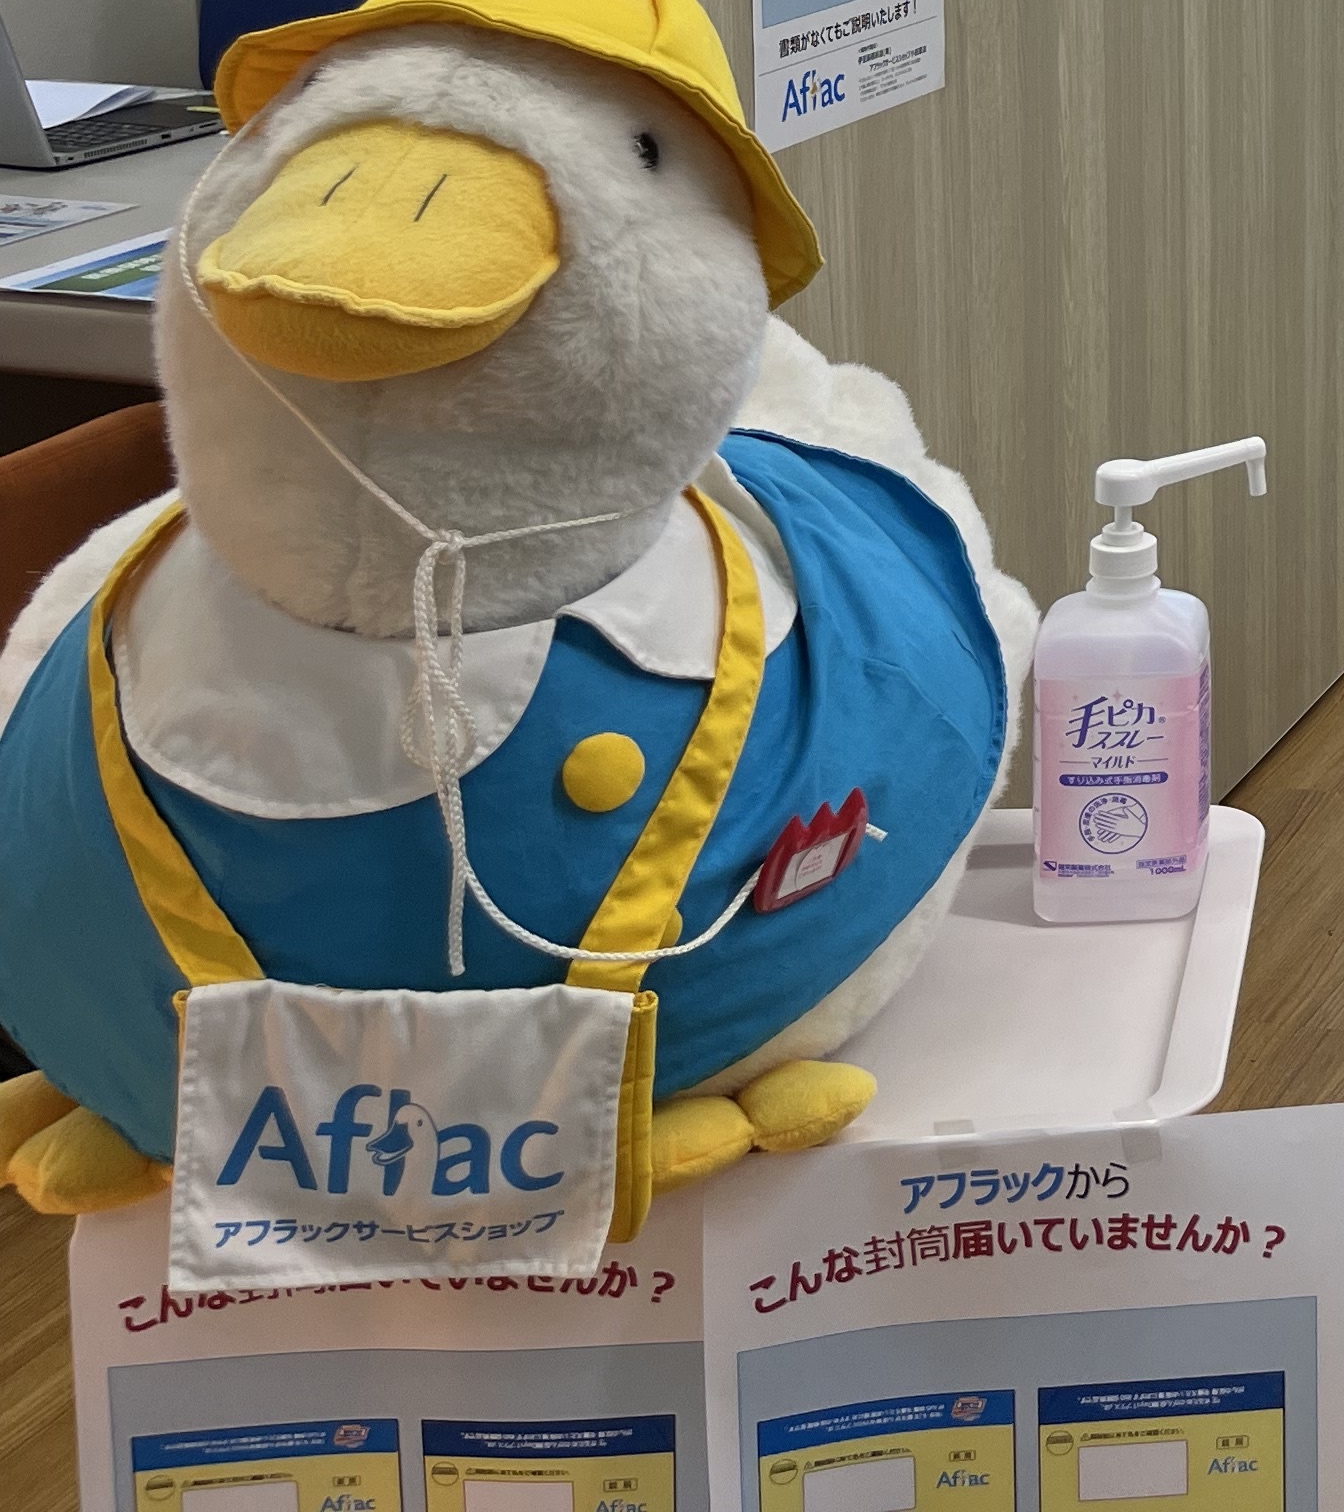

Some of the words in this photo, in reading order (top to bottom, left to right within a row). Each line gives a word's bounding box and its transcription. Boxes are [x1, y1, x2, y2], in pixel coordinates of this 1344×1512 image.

[779, 0, 918, 58] 書類がなくてもご説明いたします！
[782, 70, 845, 122] Aflac
[1065, 696, 1156, 749] 手ピカ
[1090, 755, 1136, 769] マイルド
[216, 1084, 564, 1197] Aflac
[900, 1160, 1129, 1214] アフラックから
[215, 1209, 564, 1248] アフラックサービスショップ
[749, 1212, 1286, 1314] こんな封筒届いていませんか？
[936, 1469, 990, 1490] Aflac
[1207, 1455, 1258, 1475] Aflac
[320, 1493, 376, 1512] Aflac
